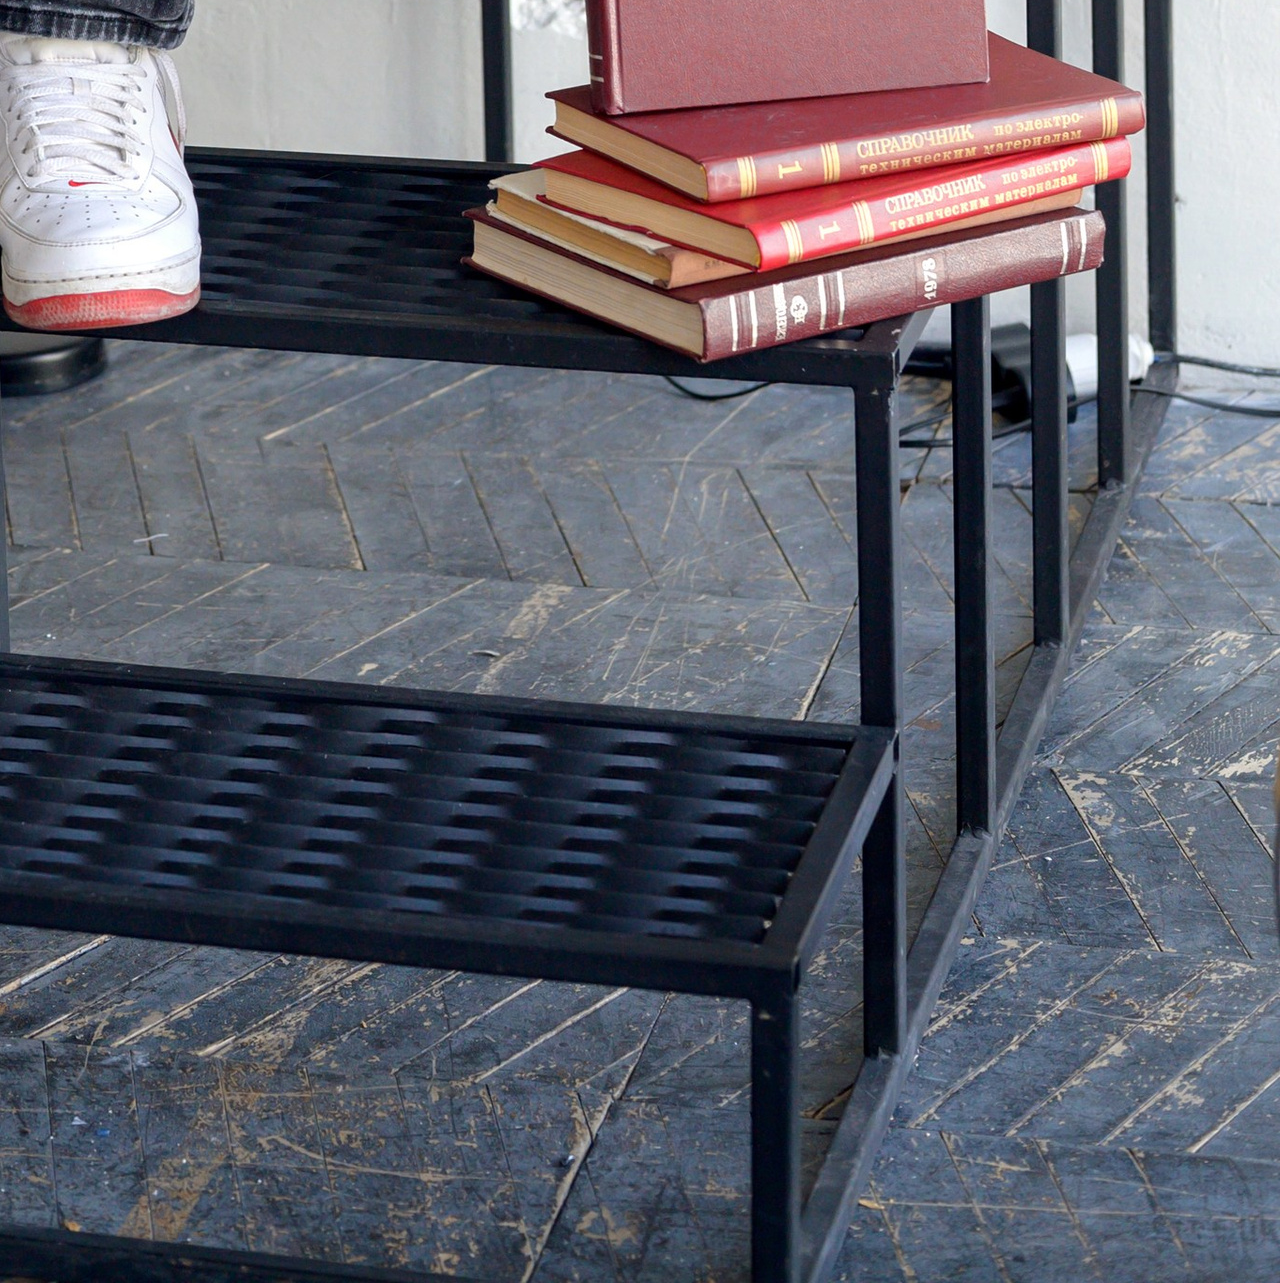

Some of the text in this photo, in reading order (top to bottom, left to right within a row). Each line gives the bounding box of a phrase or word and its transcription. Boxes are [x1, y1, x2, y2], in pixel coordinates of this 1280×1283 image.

[856, 112, 1084, 159] СПРАВОЧНИК по электро-
[859, 130, 1082, 175] техническим материалам
[778, 160, 803, 179] 1
[885, 157, 1078, 215] СПРАВОЧНИК по электро-
[889, 173, 1078, 232] техническим материалам
[818, 220, 841, 241] 1
[921, 257, 937, 300] 1978
